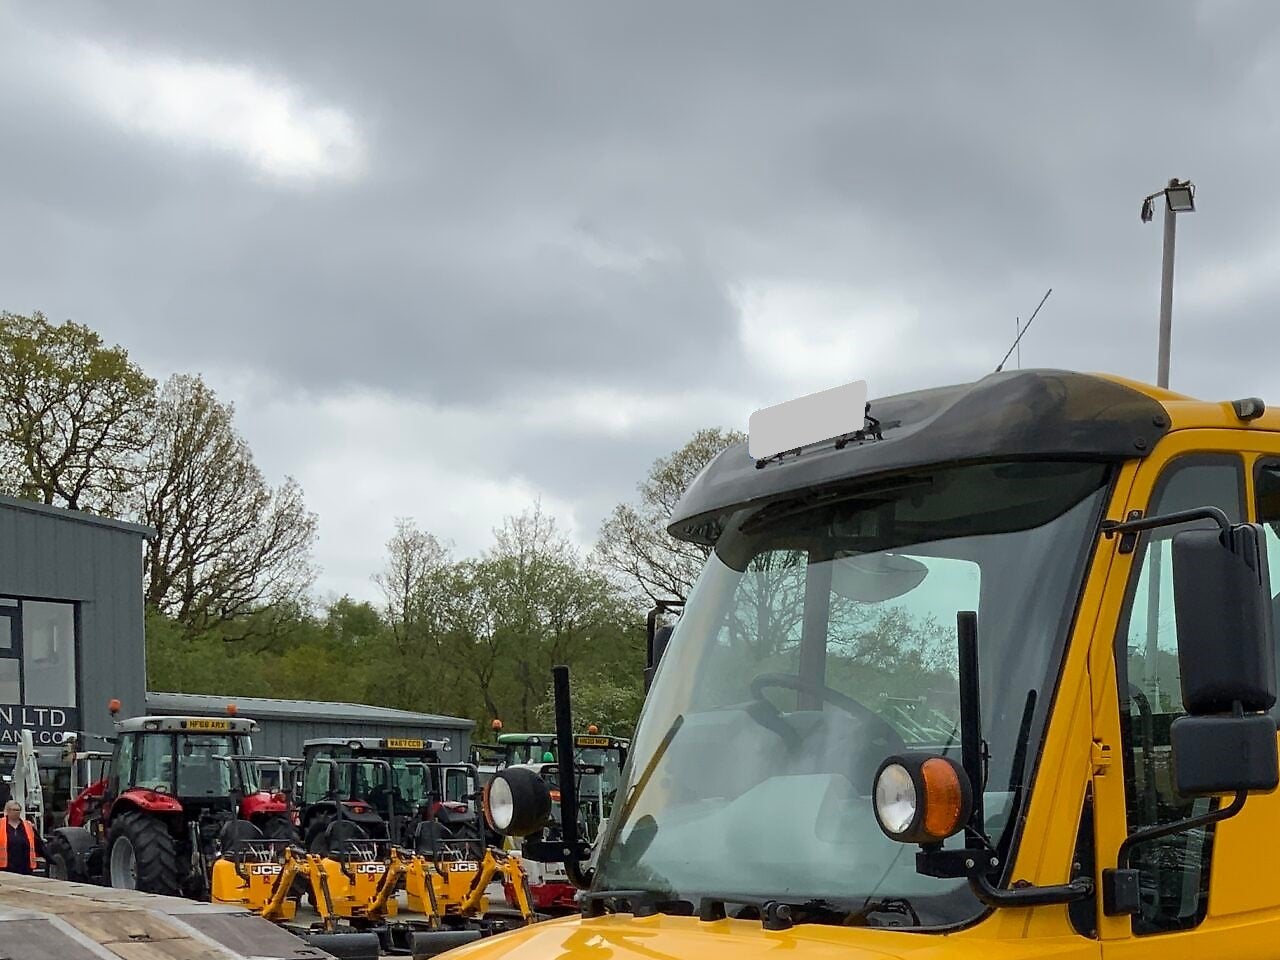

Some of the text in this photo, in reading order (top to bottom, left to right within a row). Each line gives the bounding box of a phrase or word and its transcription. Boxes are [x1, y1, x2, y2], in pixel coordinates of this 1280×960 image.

[22, 708, 66, 727] LTD
[252, 865, 282, 875] JCB
[357, 864, 386, 874] JCB
[450, 863, 478, 872] JCB
